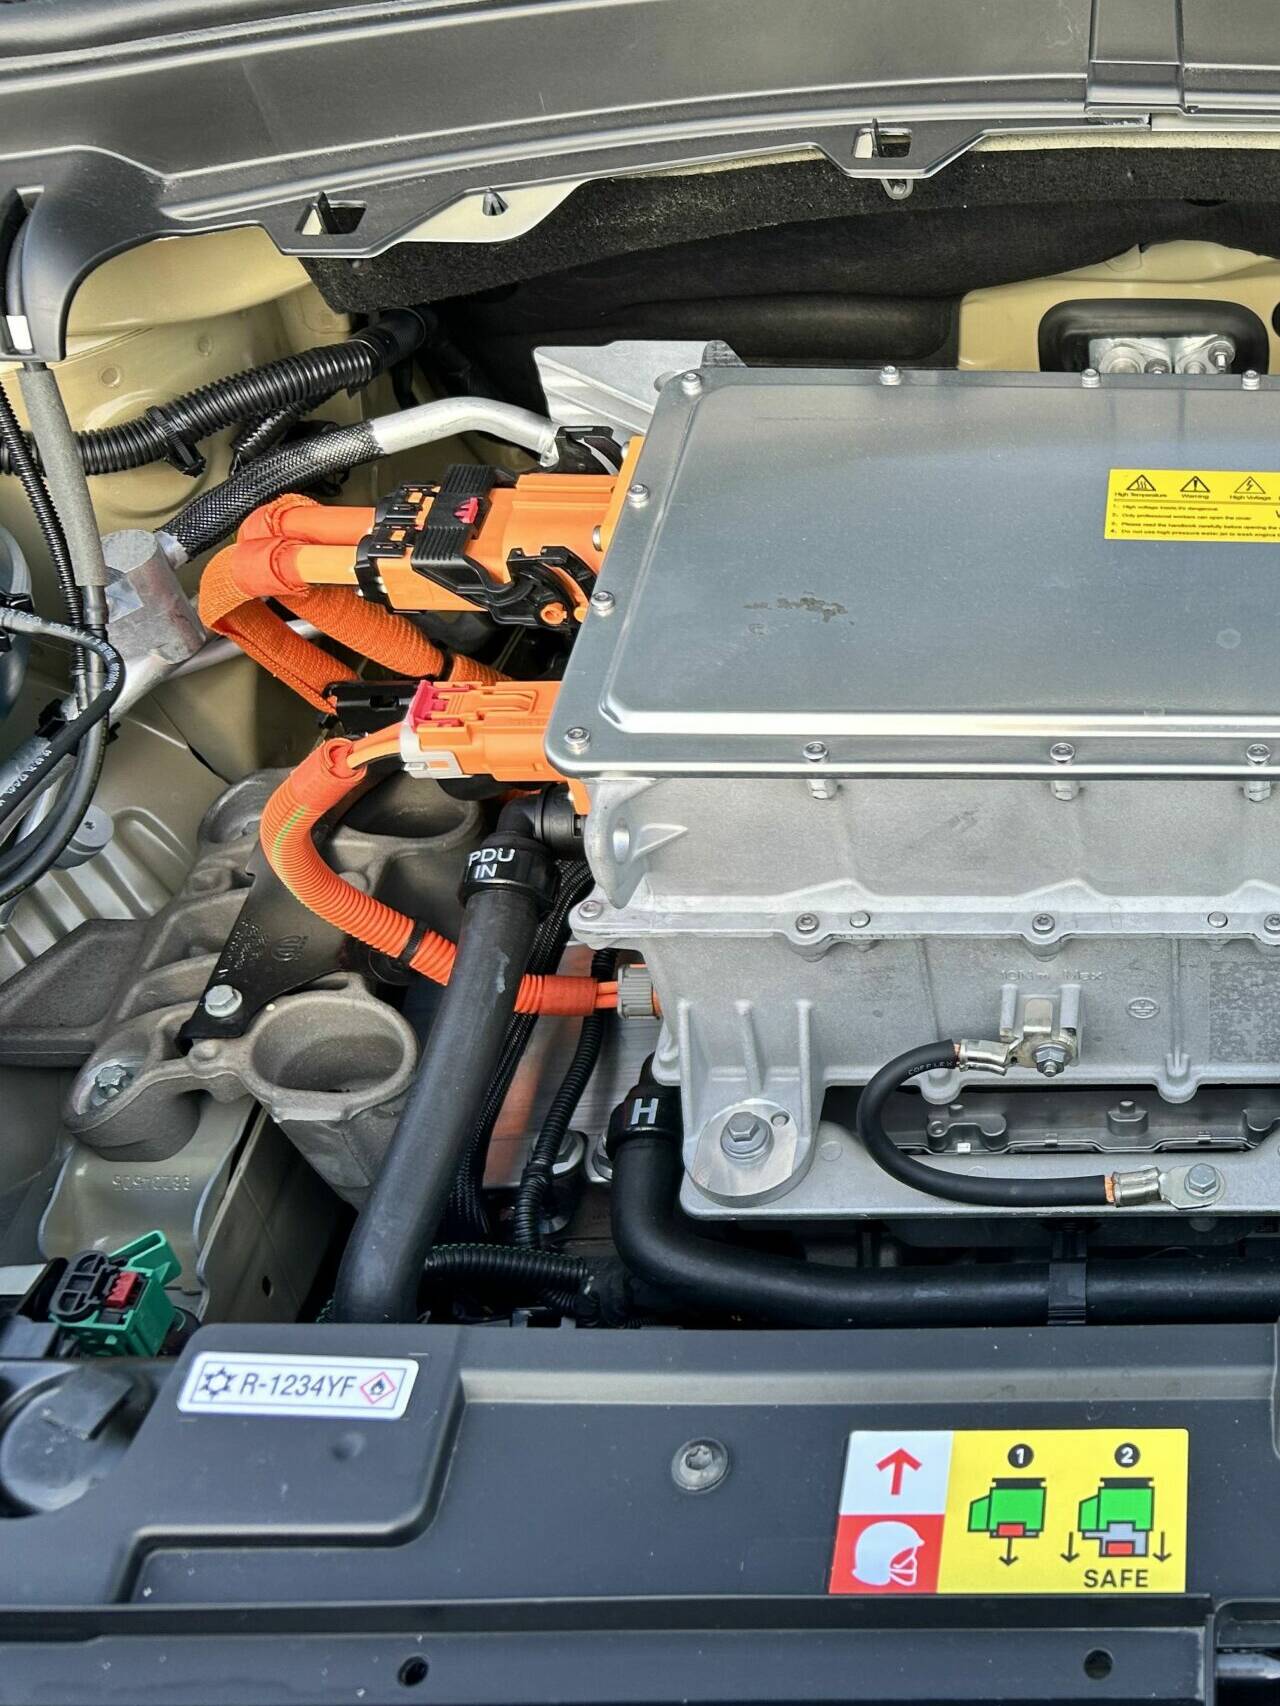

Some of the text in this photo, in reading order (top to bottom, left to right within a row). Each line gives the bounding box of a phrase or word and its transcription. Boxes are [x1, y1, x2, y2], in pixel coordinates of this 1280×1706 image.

[468, 847, 516, 867] PDU
[473, 863, 498, 880] IN
[630, 1098, 660, 1126] H
[239, 1372, 358, 1398] R-1234YF
[1015, 1447, 1134, 1463] 1 2
[1084, 1568, 1150, 1589] SAFE
